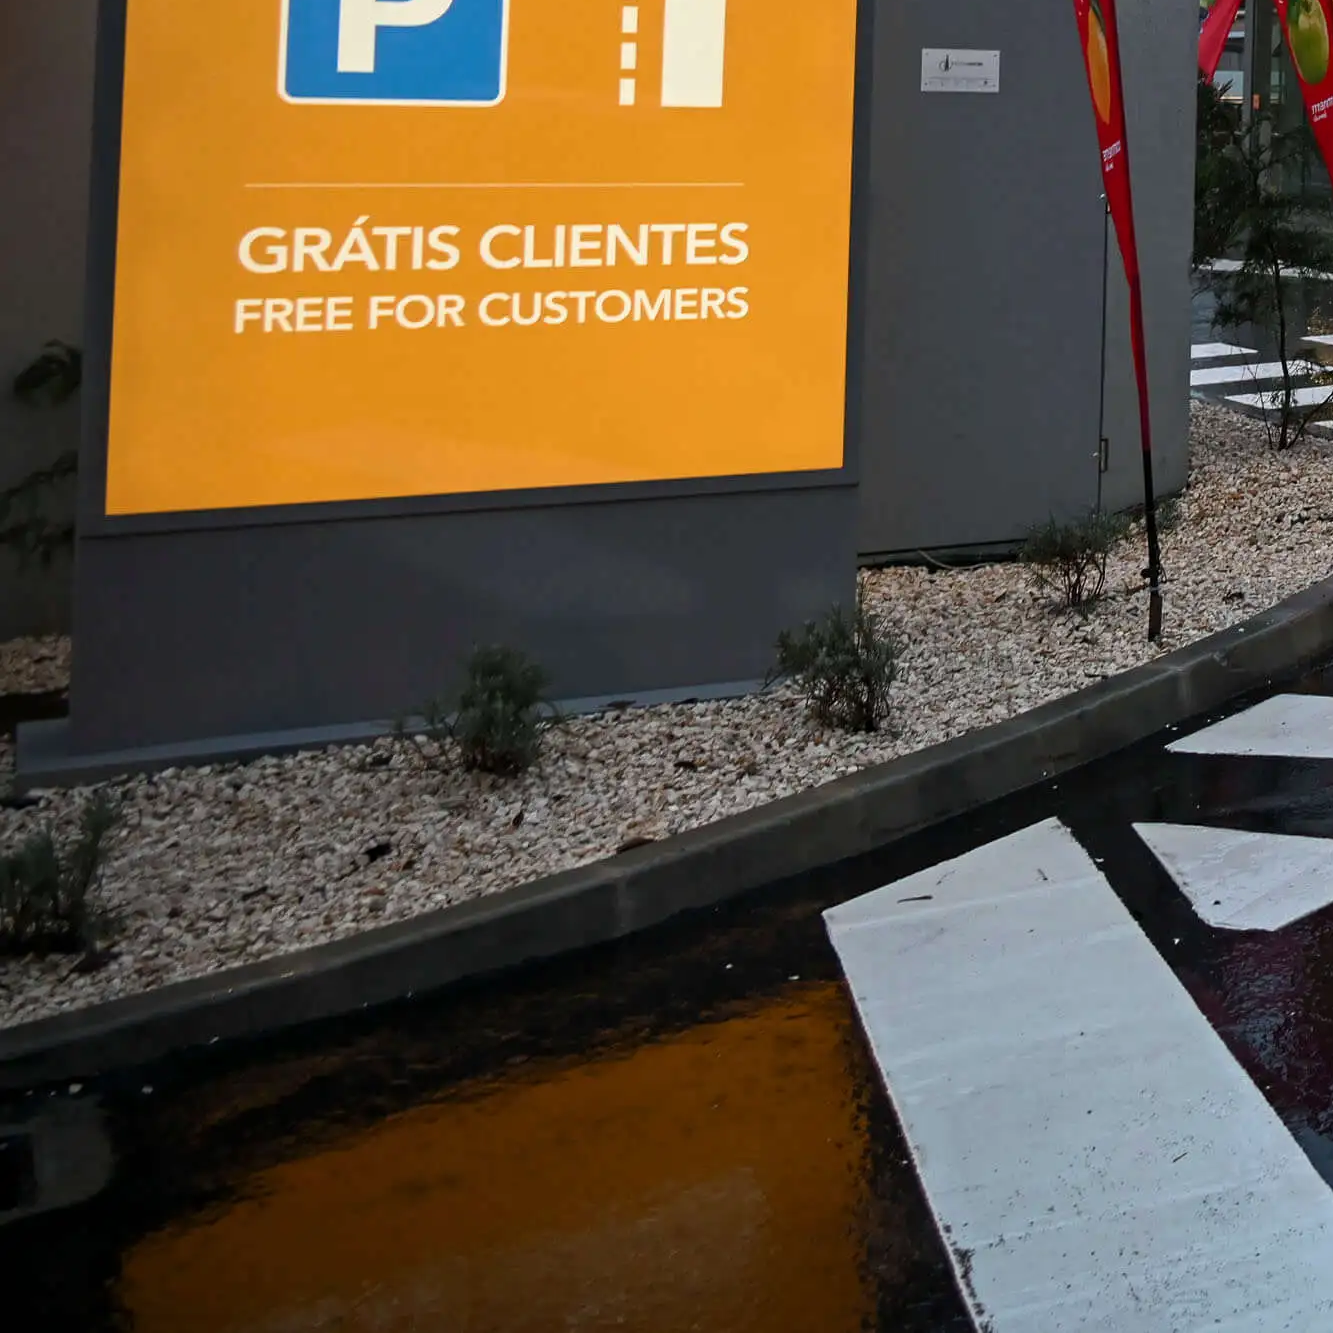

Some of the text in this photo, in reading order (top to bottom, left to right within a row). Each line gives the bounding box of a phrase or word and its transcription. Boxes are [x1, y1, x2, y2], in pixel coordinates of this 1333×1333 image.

[238, 215, 749, 274] GRÁTIS CLIENTES
[234, 286, 749, 334] FREE FOR CUSTOMERS
